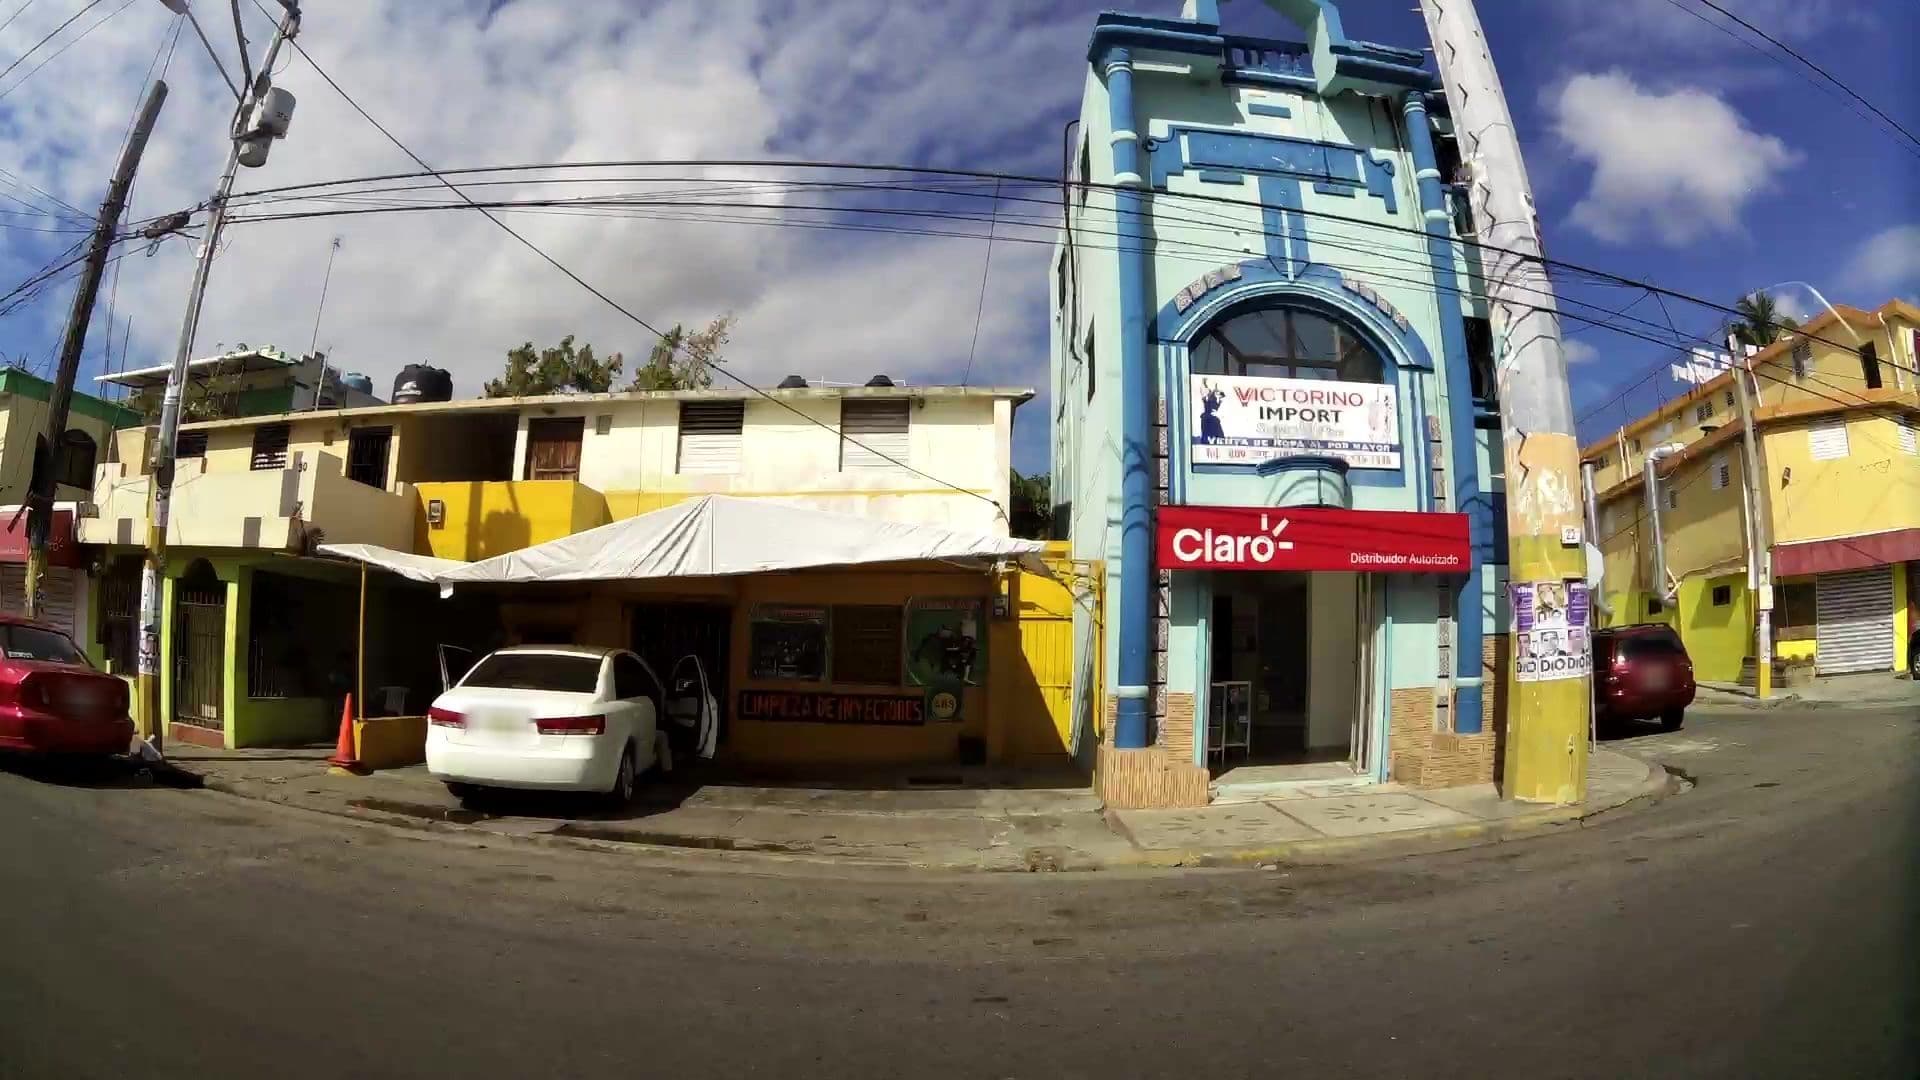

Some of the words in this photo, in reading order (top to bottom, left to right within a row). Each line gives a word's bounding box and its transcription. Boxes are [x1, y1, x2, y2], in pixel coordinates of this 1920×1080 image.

[1233, 385, 1364, 407] VICTORINO
[1259, 406, 1343, 423] IMPORT
[1208, 435, 1249, 447] VENTA
[1253, 438, 1269, 448] DE
[1273, 437, 1305, 449] ROPA
[1328, 442, 1349, 450] POR
[1352, 443, 1391, 453] MAYOR
[1173, 527, 1276, 563] Claro
[1350, 552, 1407, 565] Distribuidor
[1409, 553, 1459, 565] Autorizado
[1540, 657, 1566, 673] DIO
